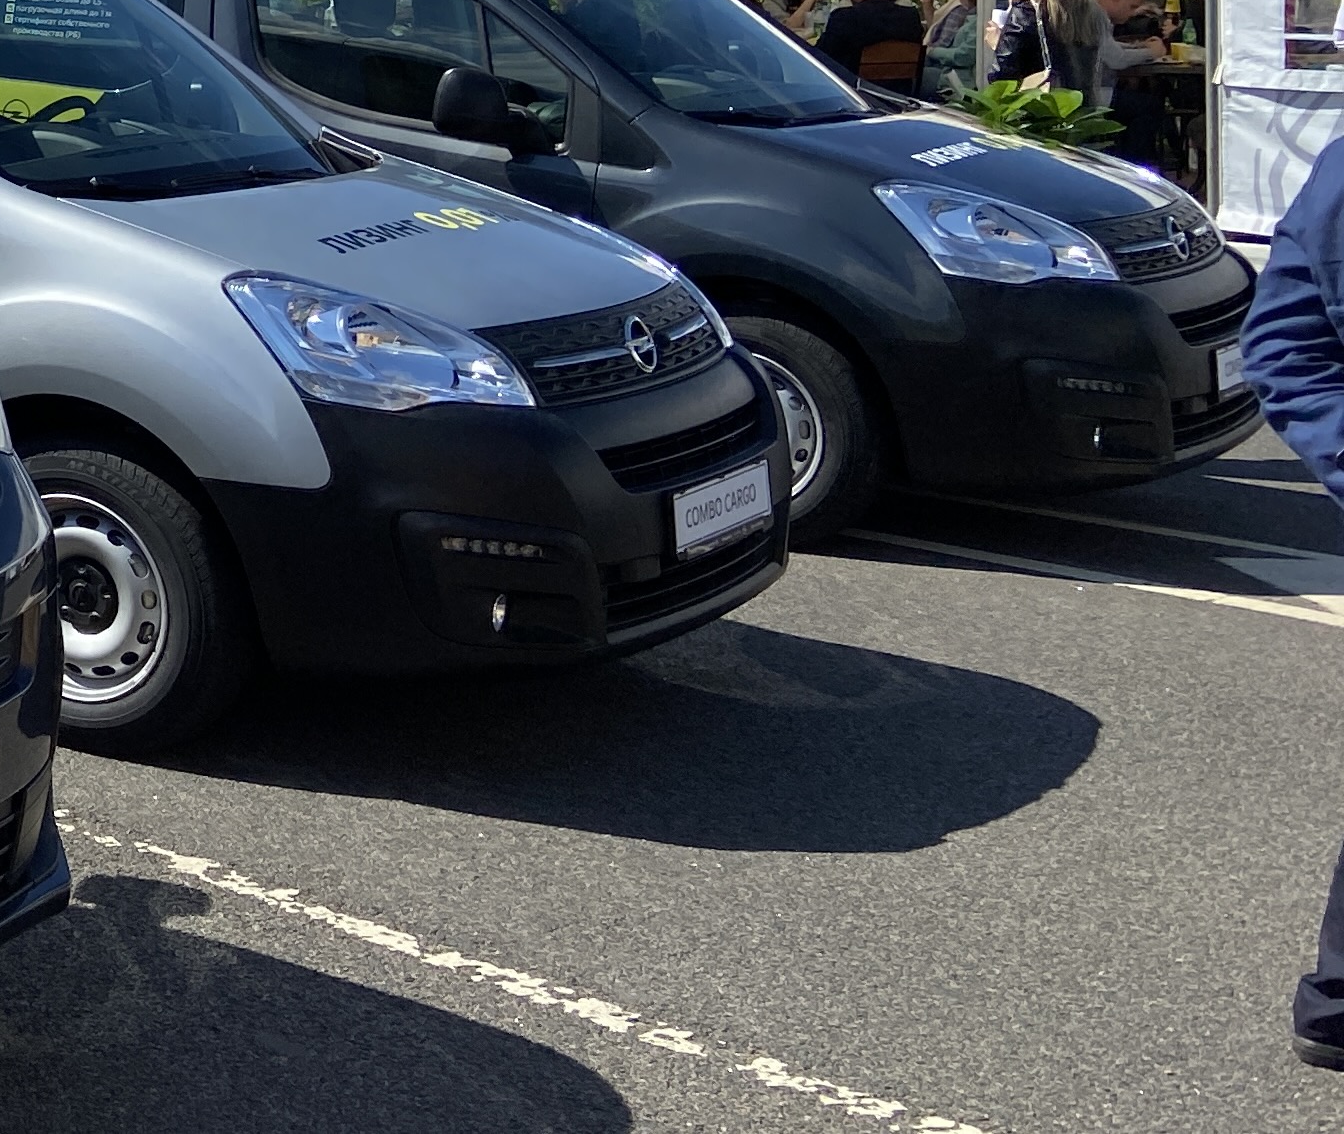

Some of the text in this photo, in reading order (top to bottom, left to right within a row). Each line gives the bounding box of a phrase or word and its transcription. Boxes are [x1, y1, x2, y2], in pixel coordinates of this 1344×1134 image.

[316, 218, 431, 254] ЛИЗИНГ
[685, 483, 757, 528] COMBO CARGO
